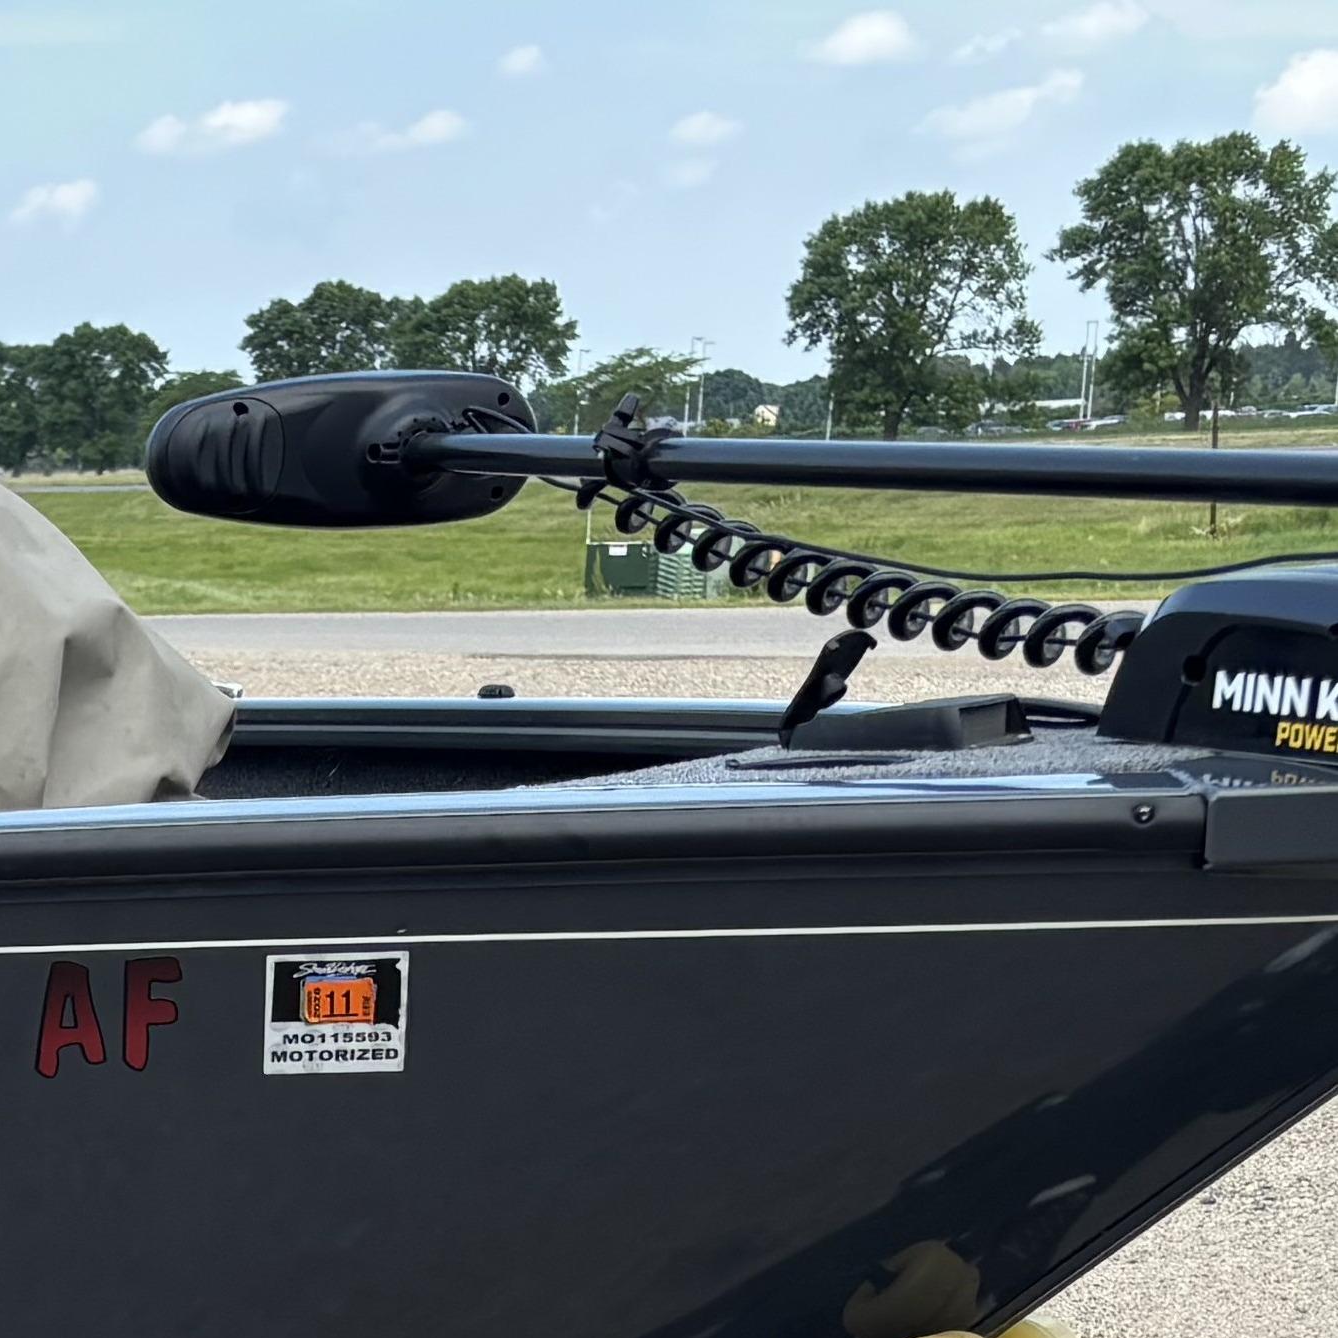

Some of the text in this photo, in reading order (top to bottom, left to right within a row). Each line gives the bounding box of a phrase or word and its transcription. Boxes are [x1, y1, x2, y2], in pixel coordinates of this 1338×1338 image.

[1212, 670, 1313, 718] MINN
[1275, 721, 1338, 753] POWE
[35, 957, 184, 1078] AF
[326, 989, 352, 1016] 11
[271, 1048, 399, 1063] MOTORIZED
